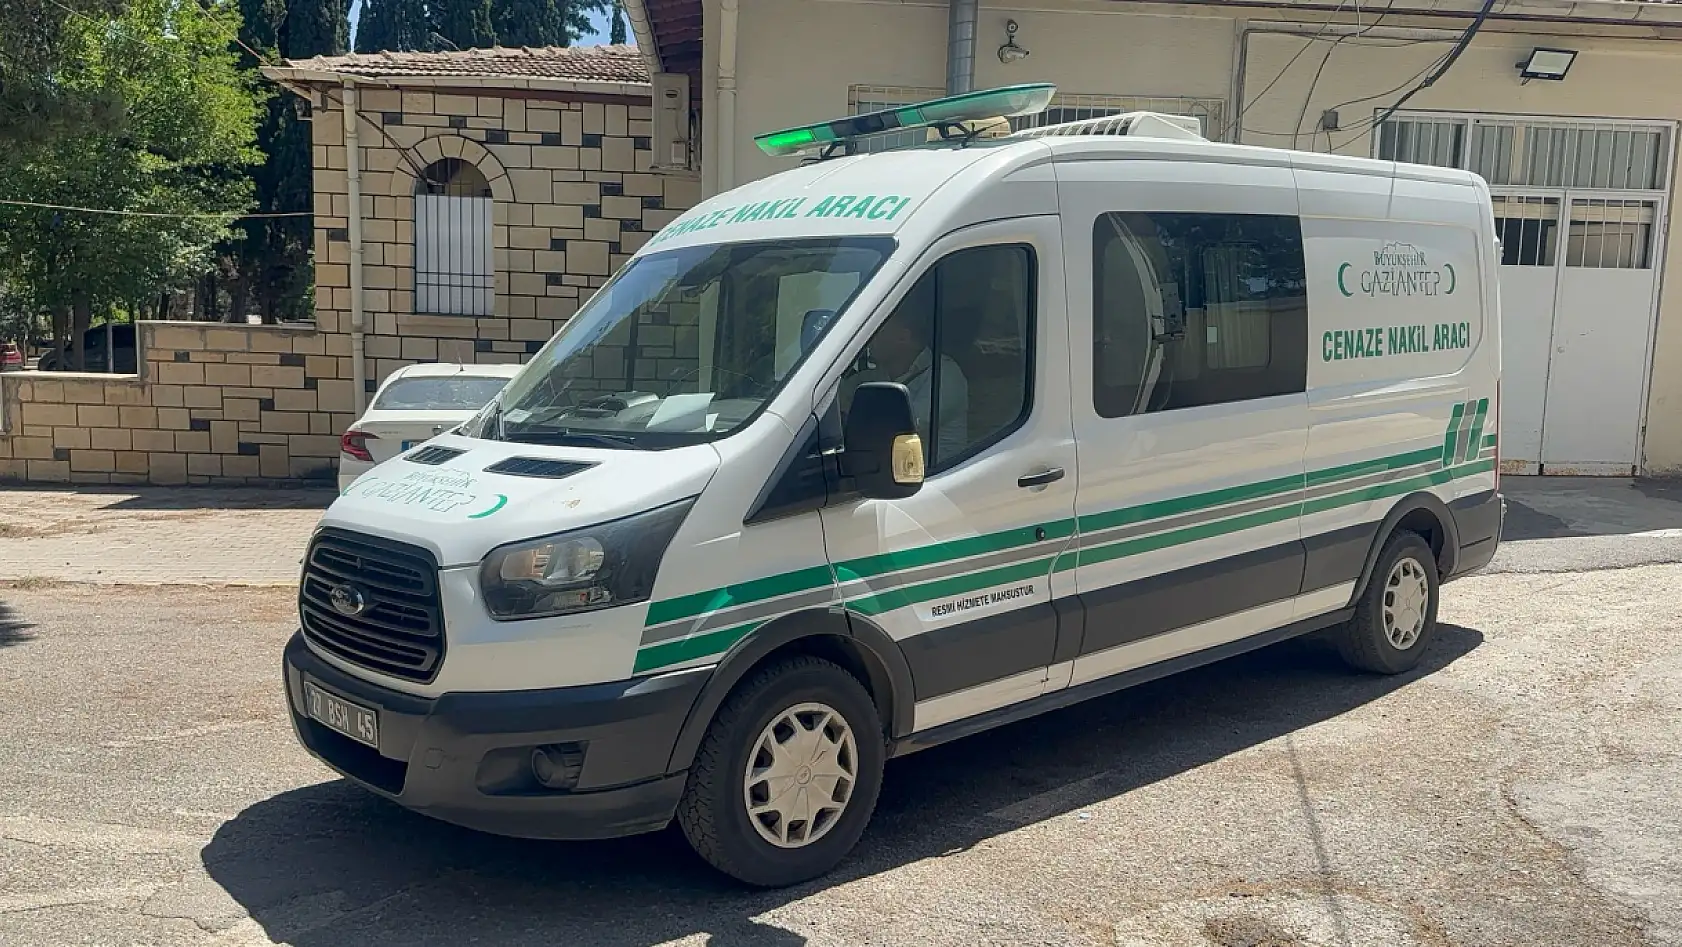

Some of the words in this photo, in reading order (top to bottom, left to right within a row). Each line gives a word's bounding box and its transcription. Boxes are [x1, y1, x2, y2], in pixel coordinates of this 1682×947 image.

[805, 195, 911, 221] ARACI
[1322, 327, 1383, 362] CENAZE
[1433, 322, 1470, 351] ARACI
[357, 711, 373, 740] 45
